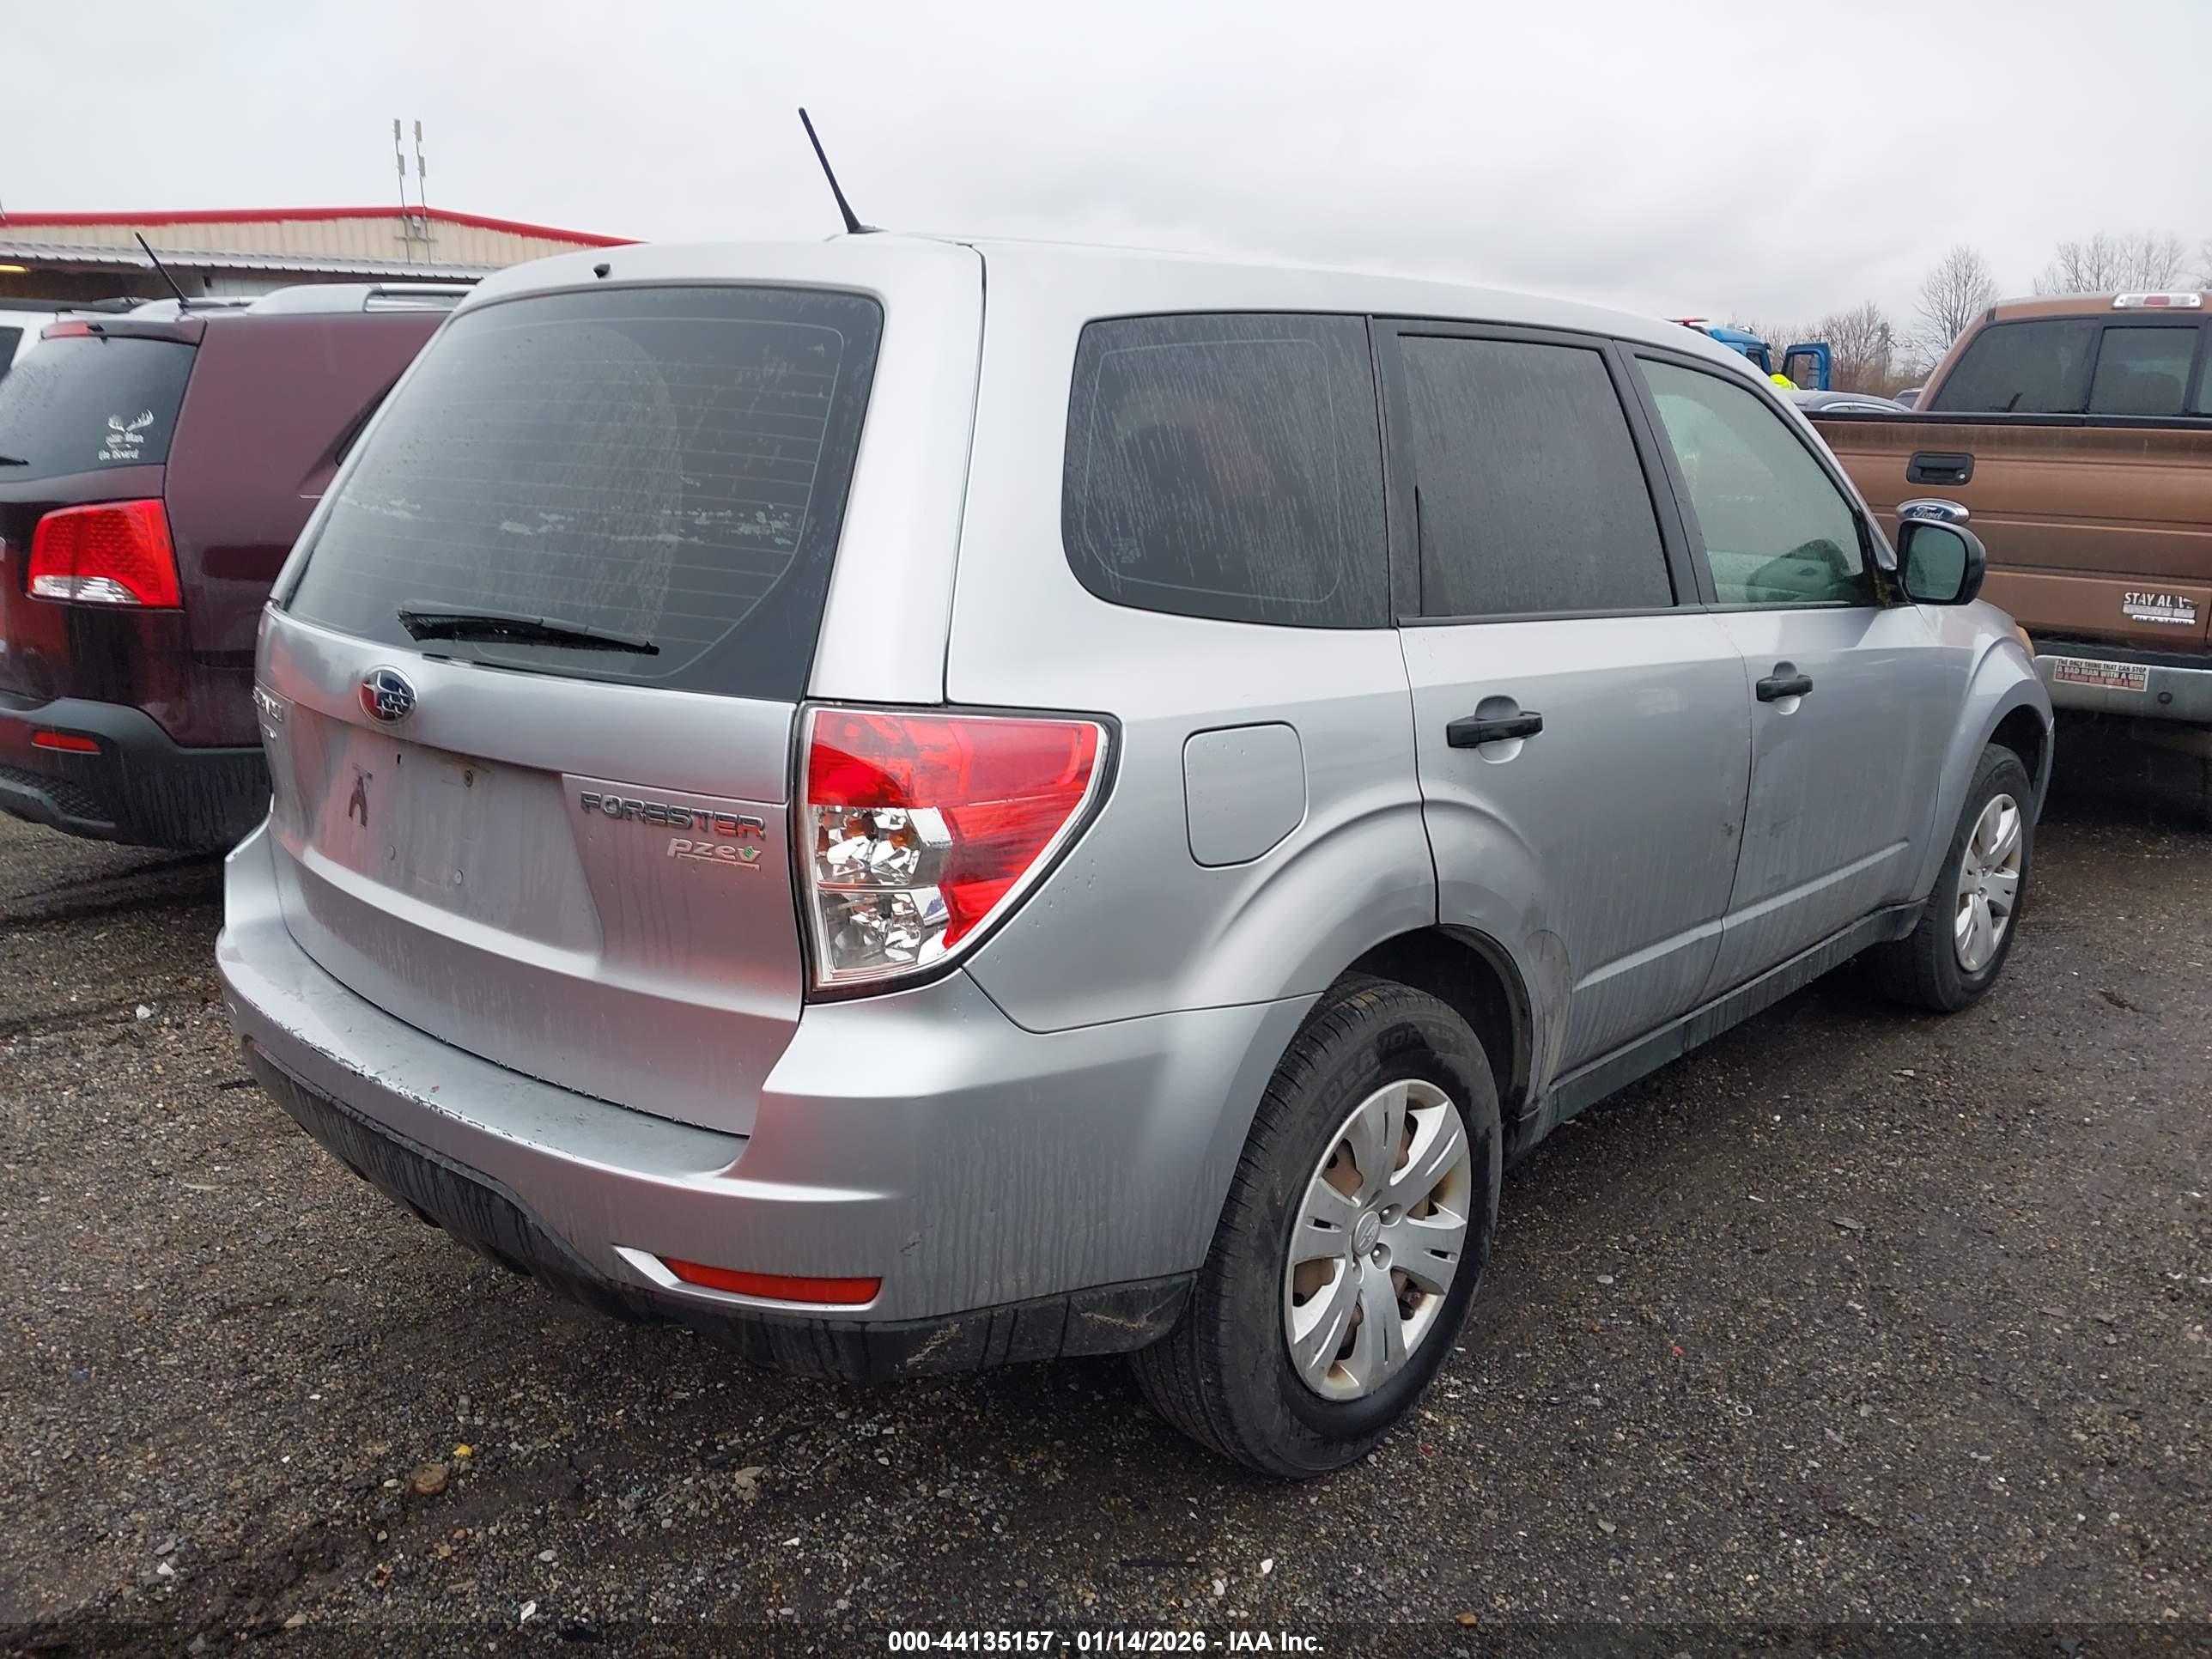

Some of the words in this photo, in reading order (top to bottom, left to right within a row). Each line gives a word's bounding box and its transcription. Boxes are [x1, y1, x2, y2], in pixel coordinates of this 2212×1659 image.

[1912, 506, 1944, 520] Ford
[2124, 592, 2155, 605] STAY
[580, 790, 767, 841] FORESTER
